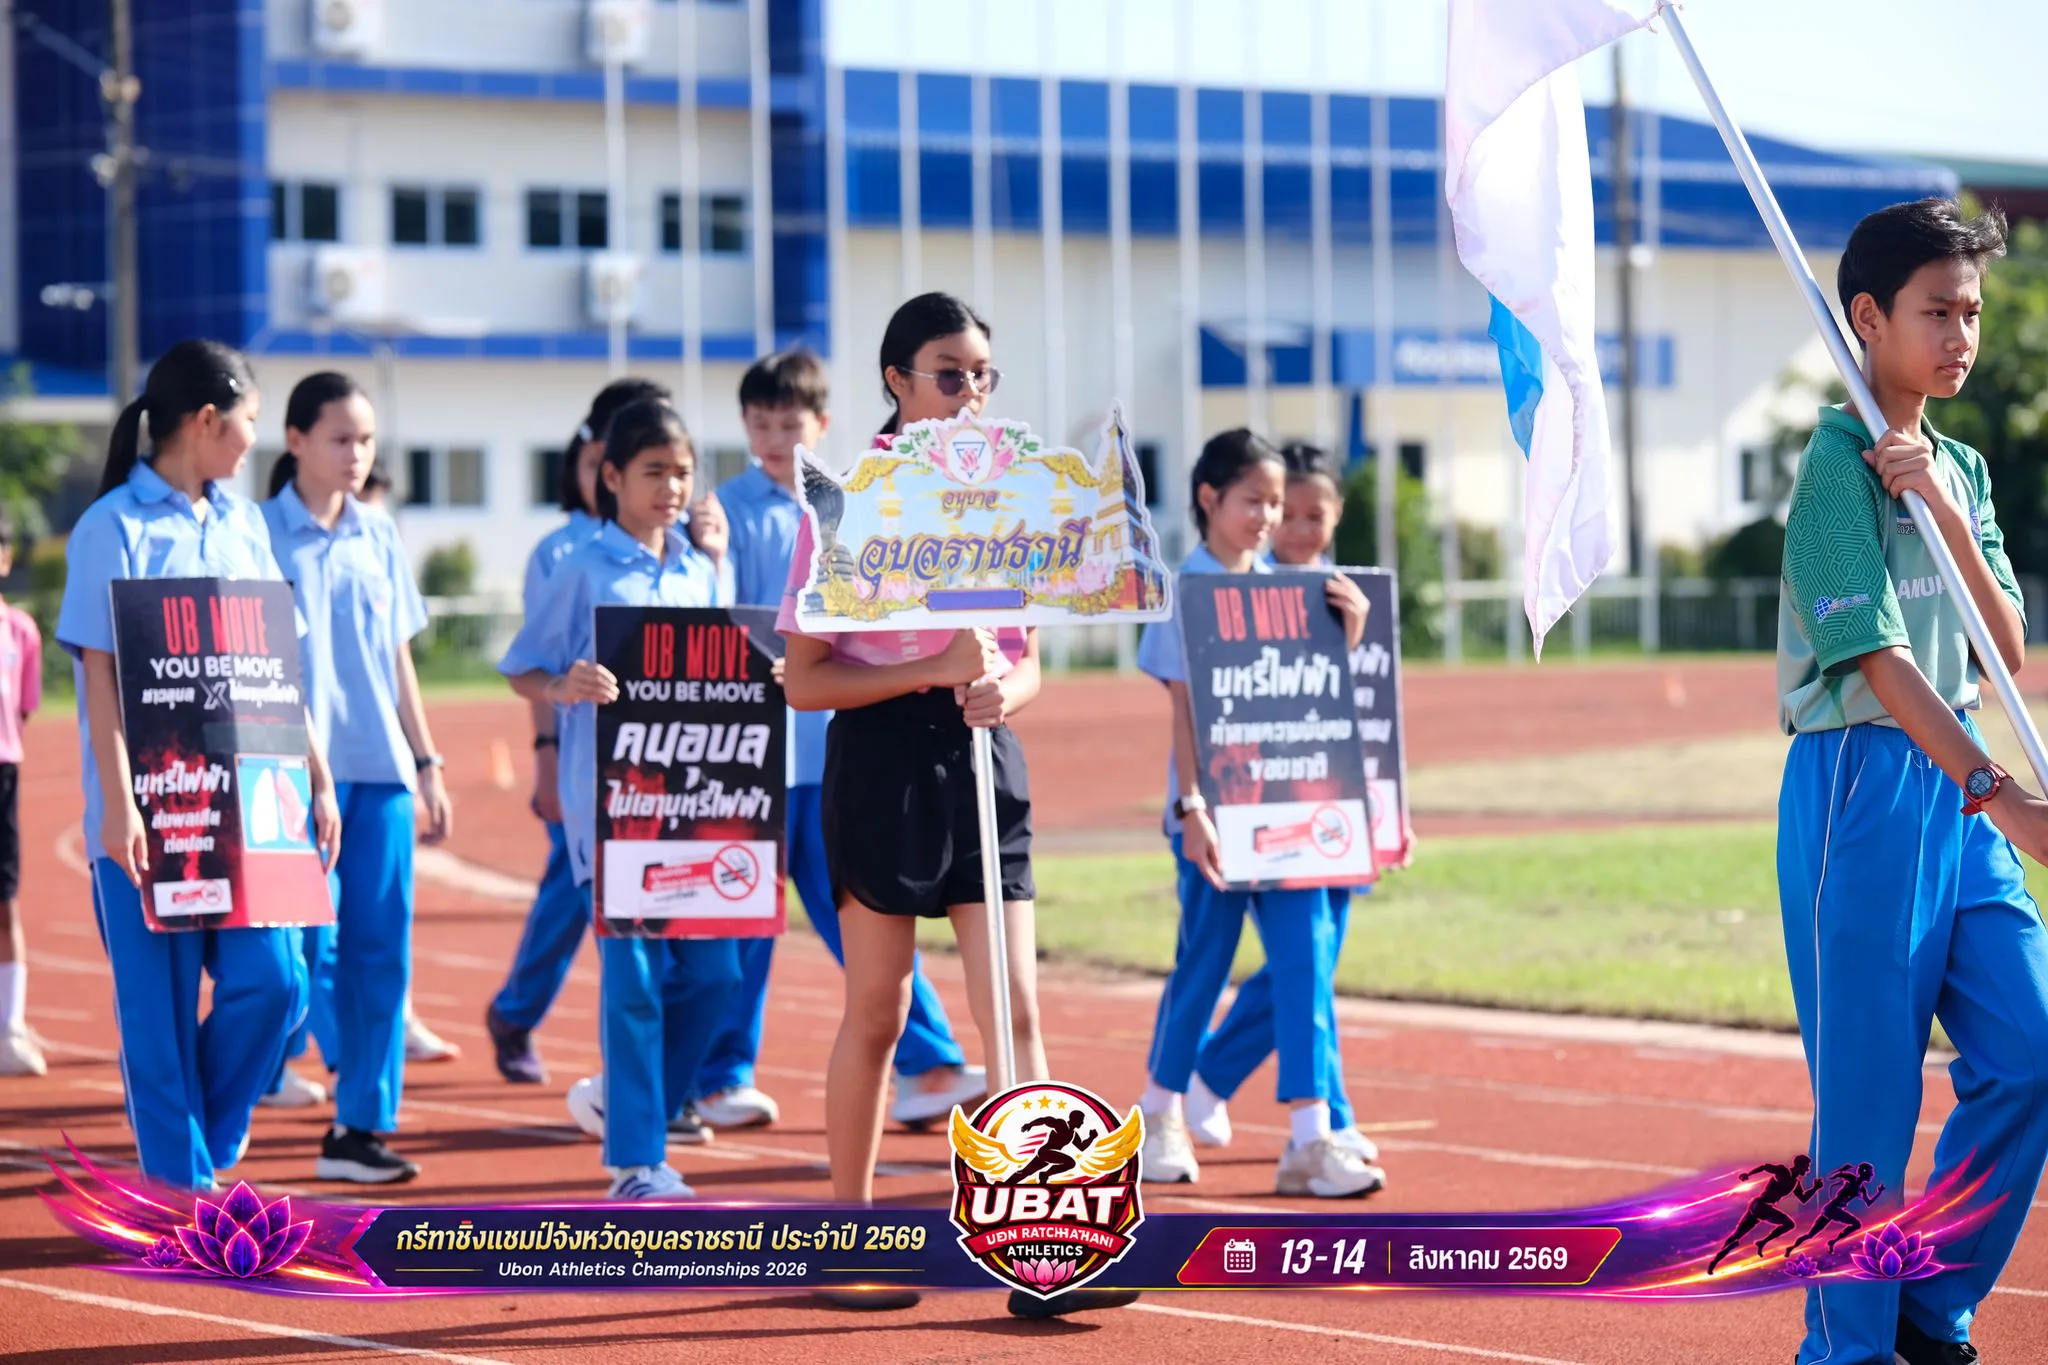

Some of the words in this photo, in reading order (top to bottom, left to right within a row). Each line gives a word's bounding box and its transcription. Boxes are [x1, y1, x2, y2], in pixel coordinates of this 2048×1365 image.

[942, 490, 998, 517] อนุบาล
[857, 517, 1092, 601] อุบลราชธานี
[162, 594, 201, 656] UB
[209, 594, 270, 656] MOVE
[1213, 586, 1247, 642] UB
[1251, 586, 1311, 641] MOVE
[150, 657, 201, 680] YOU
[204, 655, 232, 678] BE
[232, 656, 285, 680] MOVE
[643, 623, 675, 679] UB
[686, 624, 751, 681] MOVE
[625, 680, 672, 702] YOU
[674, 681, 701, 703] BE
[704, 682, 766, 704] MOVE
[612, 720, 772, 790] คนอุบล
[605, 778, 773, 832] ไม่เอาบุหรี่ไฟฟ้า
